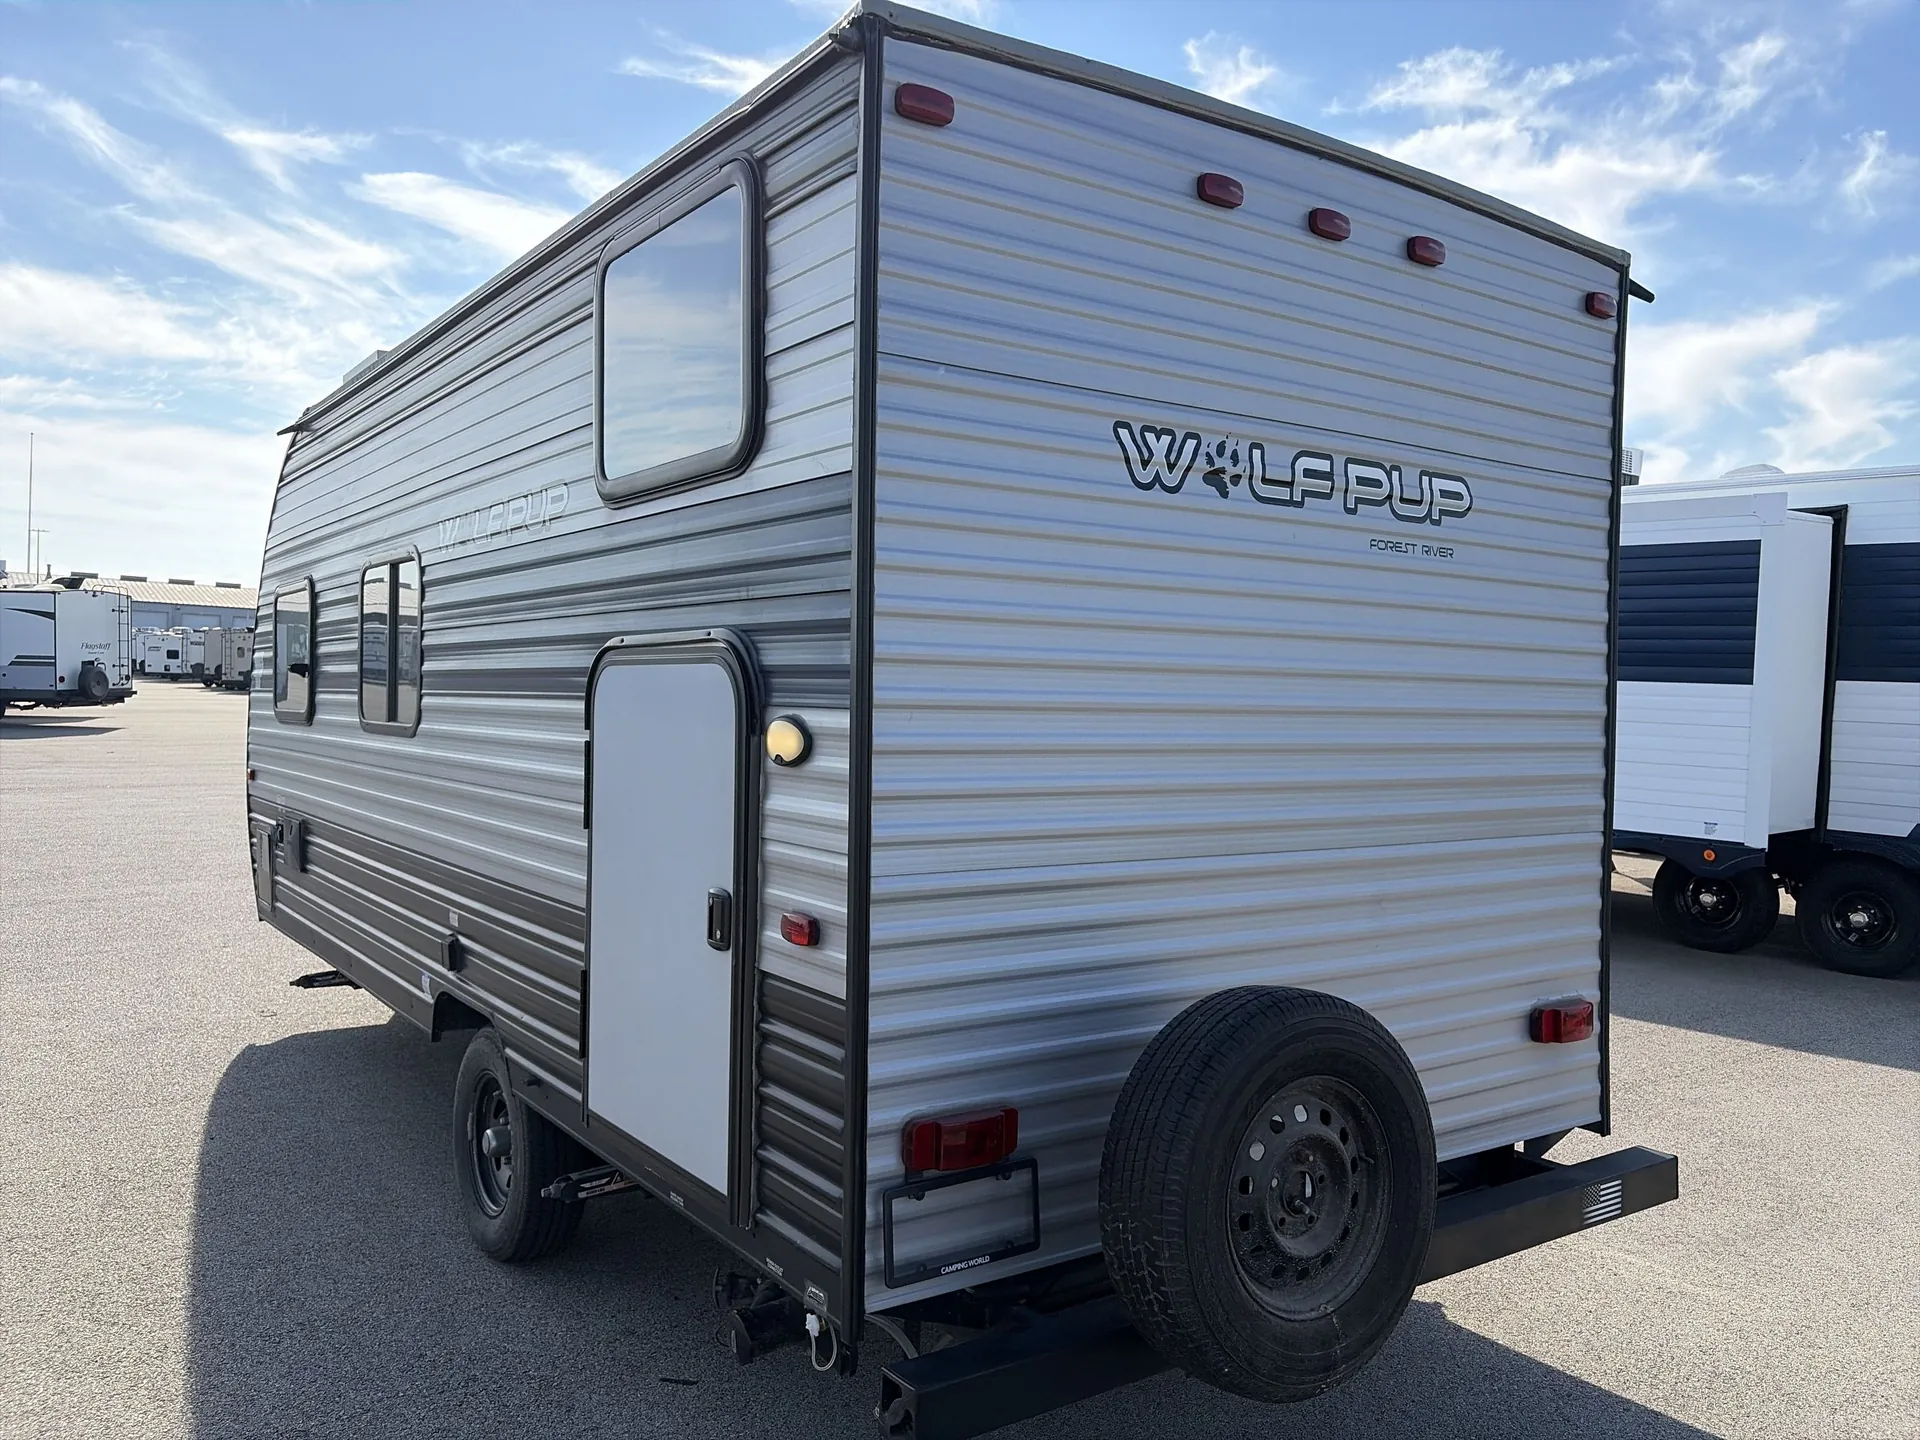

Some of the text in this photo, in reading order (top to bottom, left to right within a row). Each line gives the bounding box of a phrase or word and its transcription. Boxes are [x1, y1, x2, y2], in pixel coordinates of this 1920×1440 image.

[1343, 456, 1474, 527] PUP
[507, 479, 570, 542] PUP
[1369, 538, 1455, 559] FOREST RIVER
[80, 642, 111, 651] Flagstaff
[940, 1255, 991, 1275] CAMPING WORLD
